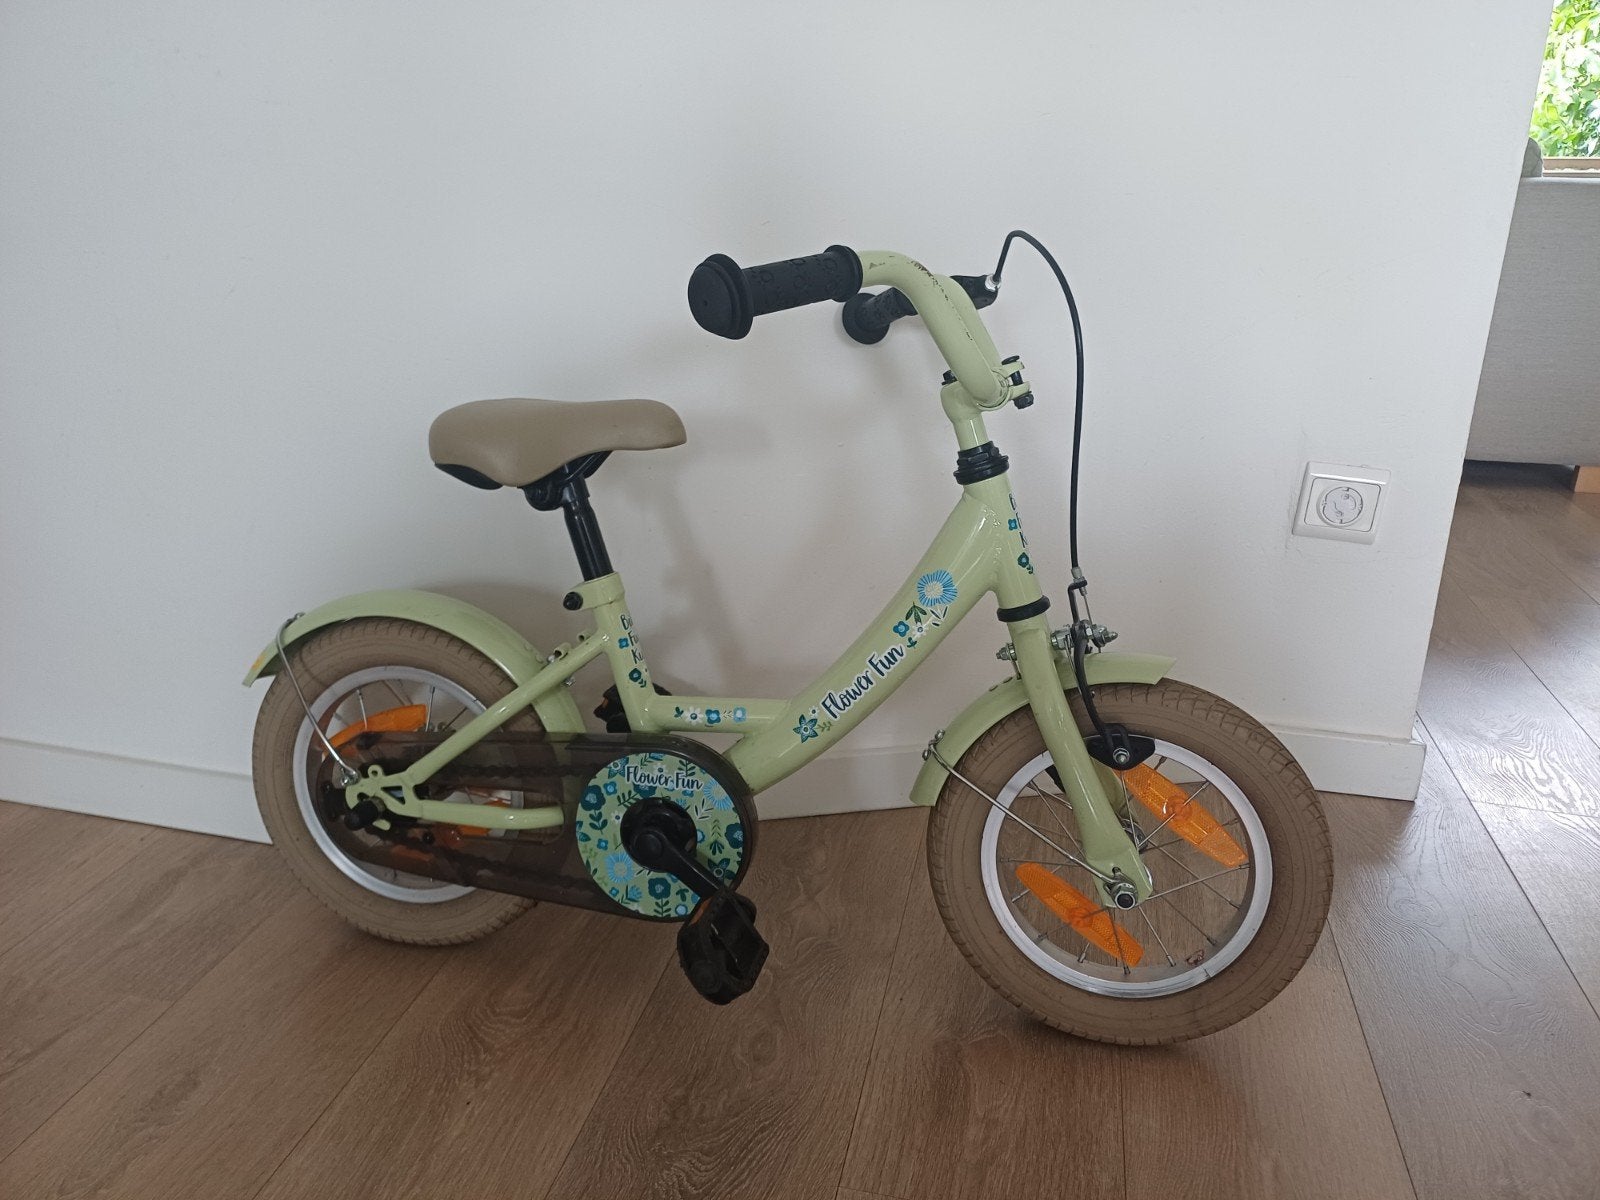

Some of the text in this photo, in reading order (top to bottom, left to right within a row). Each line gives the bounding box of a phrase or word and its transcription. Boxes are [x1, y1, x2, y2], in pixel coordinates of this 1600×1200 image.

[821, 645, 905, 719] Flower Fun
[626, 766, 703, 790] Flower Fun
